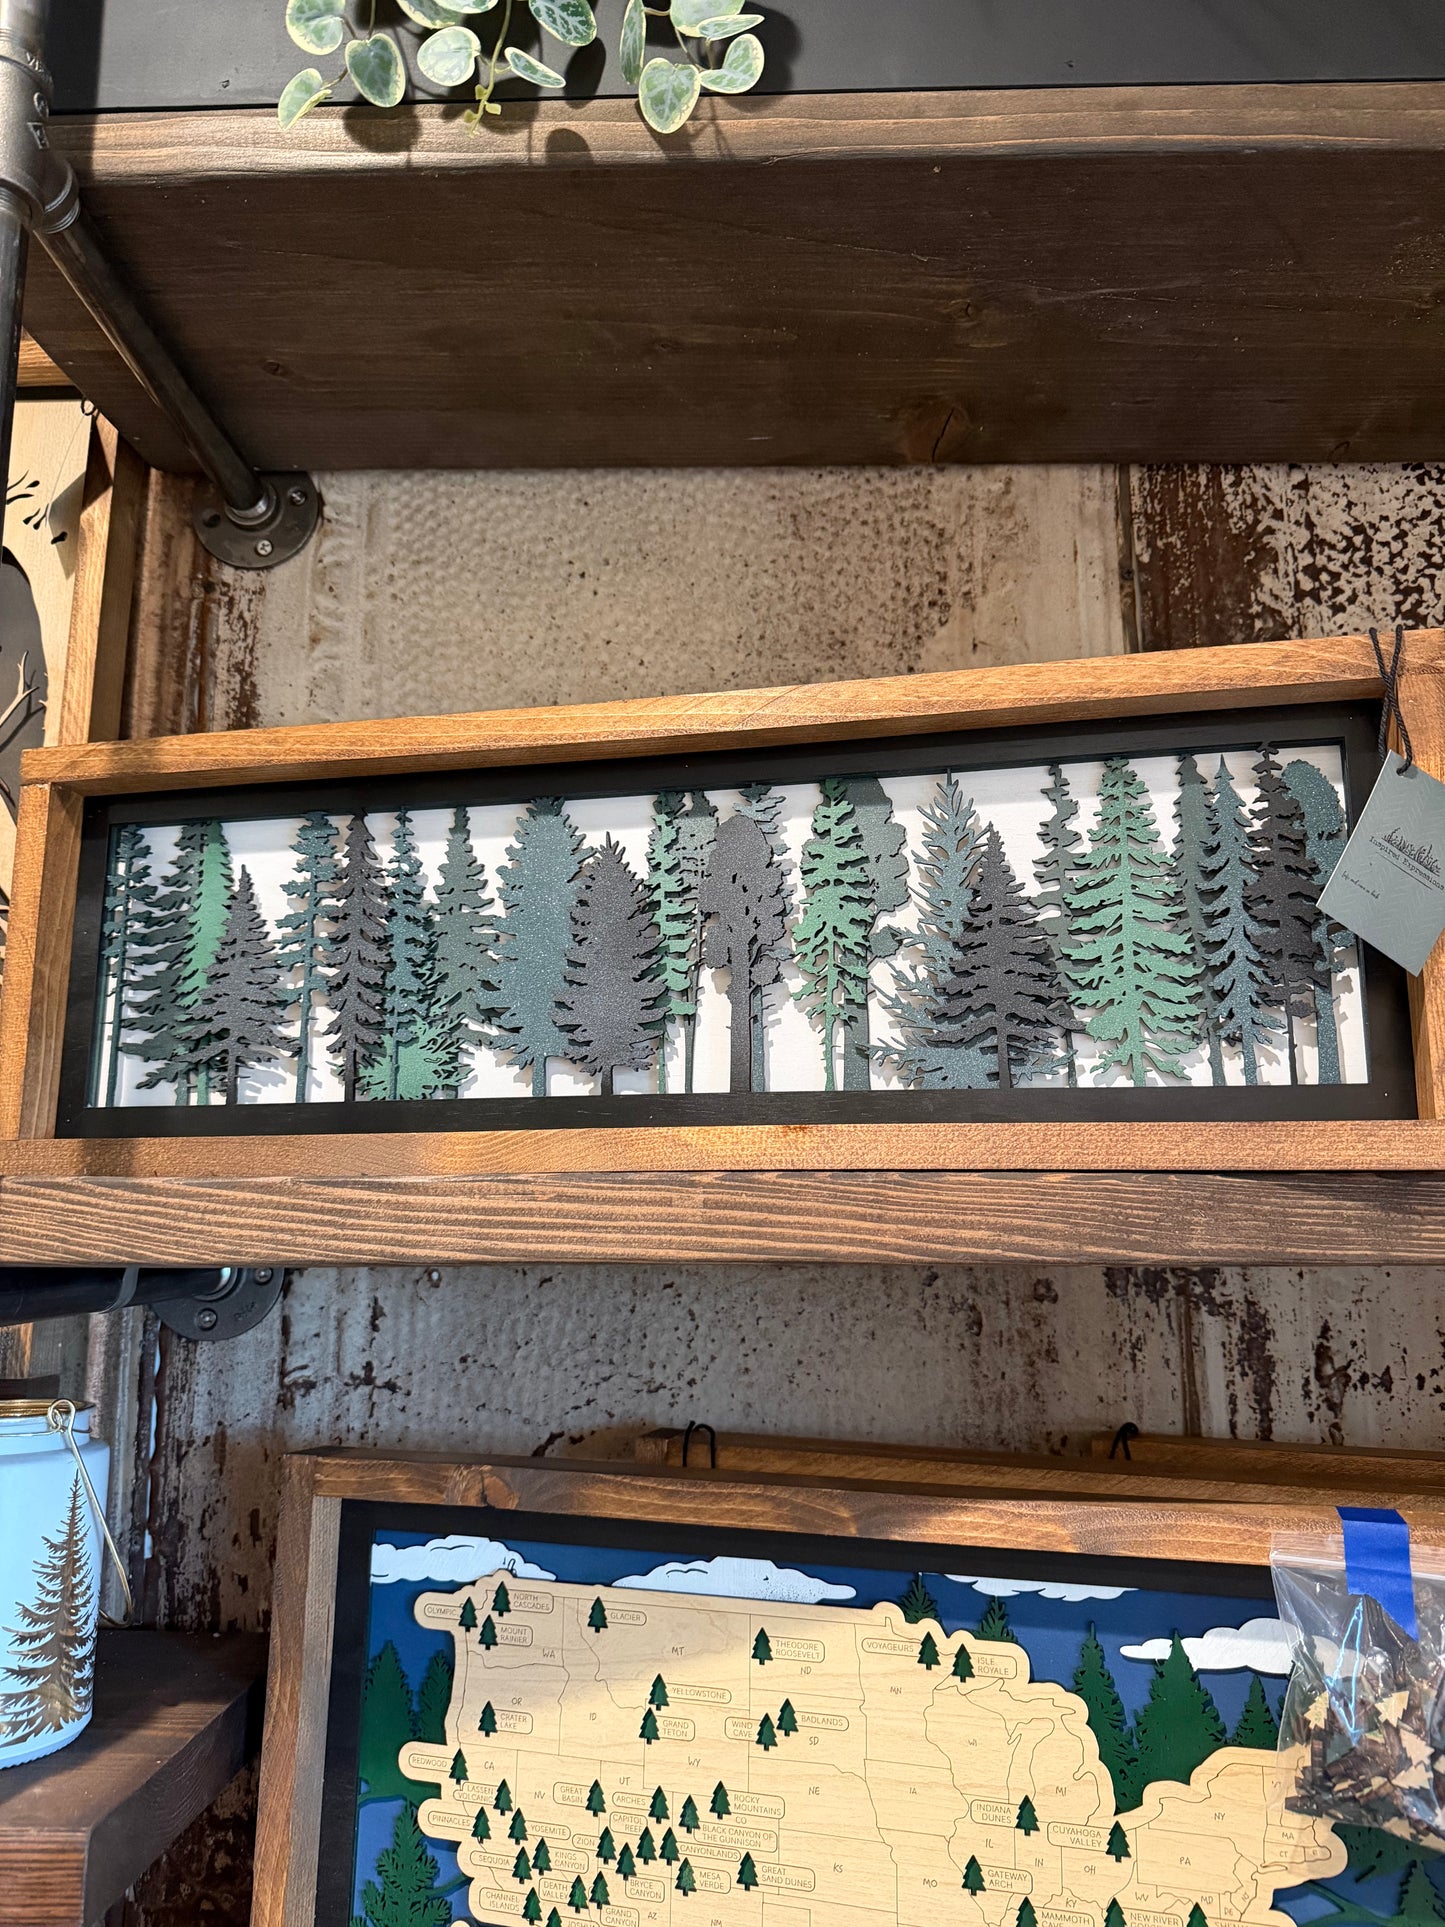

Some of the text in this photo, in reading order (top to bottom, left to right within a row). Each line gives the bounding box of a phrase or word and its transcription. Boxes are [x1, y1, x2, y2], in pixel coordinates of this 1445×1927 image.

[1369, 836, 1400, 860] Inspired
[1402, 858, 1444, 890] Expressions
[513, 1593, 539, 1602] NORTH
[513, 1601, 550, 1611] CASCADES
[427, 1607, 457, 1616] OLYMPIC
[610, 1612, 641, 1622] GLACIER
[500, 1627, 527, 1636] MOUNT
[500, 1635, 528, 1644] RAINIER
[776, 1639, 819, 1651] THEODORE
[866, 1641, 914, 1653] VOYAGEURS
[542, 1648, 556, 1659] WA
[671, 1646, 685, 1656] MT
[775, 1648, 820, 1660] ROOSEVELT
[977, 1656, 995, 1666] ISLE
[800, 1666, 812, 1675] ND
[977, 1666, 1009, 1676] ROYALE
[672, 1687, 727, 1700] YELLOWSTONE
[890, 1686, 902, 1695] MN
[512, 1697, 523, 1706] OR
[500, 1713, 527, 1723] CRATER
[589, 1712, 597, 1721] ID
[801, 1714, 844, 1727] BADLANDS
[500, 1721, 517, 1730] LAKE
[662, 1719, 689, 1729] GRAND
[732, 1720, 753, 1730] WIND
[662, 1728, 688, 1737] TETON
[733, 1729, 753, 1738] CAVE
[809, 1736, 819, 1746] SD
[968, 1739, 977, 1747] WI
[412, 1756, 447, 1768] REDWOOD
[484, 1761, 495, 1771] CA
[687, 1756, 701, 1767] WY
[619, 1777, 631, 1786] UT
[467, 1784, 494, 1794] LASSEN
[560, 1785, 583, 1795] GREAT
[808, 1786, 820, 1795] NE
[909, 1787, 917, 1795] IA
[1055, 1786, 1067, 1797] MI
[458, 1792, 494, 1803] VOLCANIC
[534, 1790, 546, 1800] NV
[561, 1794, 583, 1804] BASIN
[733, 1794, 760, 1804] ROCKY
[616, 1795, 646, 1806] ARCHES
[734, 1803, 782, 1816] MOUNTAINS
[976, 1803, 1012, 1815] INDIANA
[432, 1814, 471, 1826] PINNACLES
[612, 1814, 643, 1825] CAPITOL
[735, 1816, 747, 1824] CO
[981, 1813, 1012, 1824] DUNES
[1214, 1812, 1226, 1821] NY
[530, 1825, 567, 1836] YOSEMITE
[625, 1824, 643, 1834] REEF
[702, 1824, 774, 1841] BLACK CANYON OF
[1052, 1825, 1102, 1839] CUYAHOGA
[702, 1833, 761, 1848] THE GUNNISON
[1282, 1832, 1294, 1840] MA
[576, 1837, 595, 1847] ZION
[985, 1838, 994, 1849] IL
[1070, 1837, 1102, 1848] VALLEY
[554, 1851, 577, 1861] KINGS
[680, 1844, 738, 1860] CANYONLANDS
[478, 1854, 510, 1866] SEQUOIA
[1034, 1858, 1044, 1867] IN
[1179, 1856, 1191, 1866] PA
[554, 1860, 586, 1871] CANYON
[762, 1865, 786, 1876] GREAT
[833, 1862, 843, 1873] KS
[1083, 1865, 1096, 1875] OH
[700, 1871, 721, 1881] MESA
[987, 1869, 1028, 1881] GATEWAY
[543, 1881, 568, 1891] DEATH
[630, 1879, 654, 1889] BRYCE
[699, 1880, 725, 1890] VERDE
[762, 1875, 813, 1889] SAND DUNES
[923, 1878, 938, 1888] MO
[989, 1879, 1013, 1889] ARCH
[485, 1891, 520, 1903] CHANNEL
[542, 1889, 569, 1900] VALLEY
[629, 1888, 662, 1900] CANYON
[1135, 1891, 1149, 1902] WV
[1065, 1897, 1078, 1908] KY
[1201, 1896, 1213, 1905] MD
[489, 1901, 520, 1912] ISLANDS
[605, 1907, 632, 1918] GRAND
[648, 1912, 657, 1921] AZ
[605, 1916, 637, 1927] CANYON
[1041, 1911, 1090, 1926] MAMMOTH
[1130, 1912, 1151, 1923] NEW
[1153, 1915, 1179, 1926] RIVER
